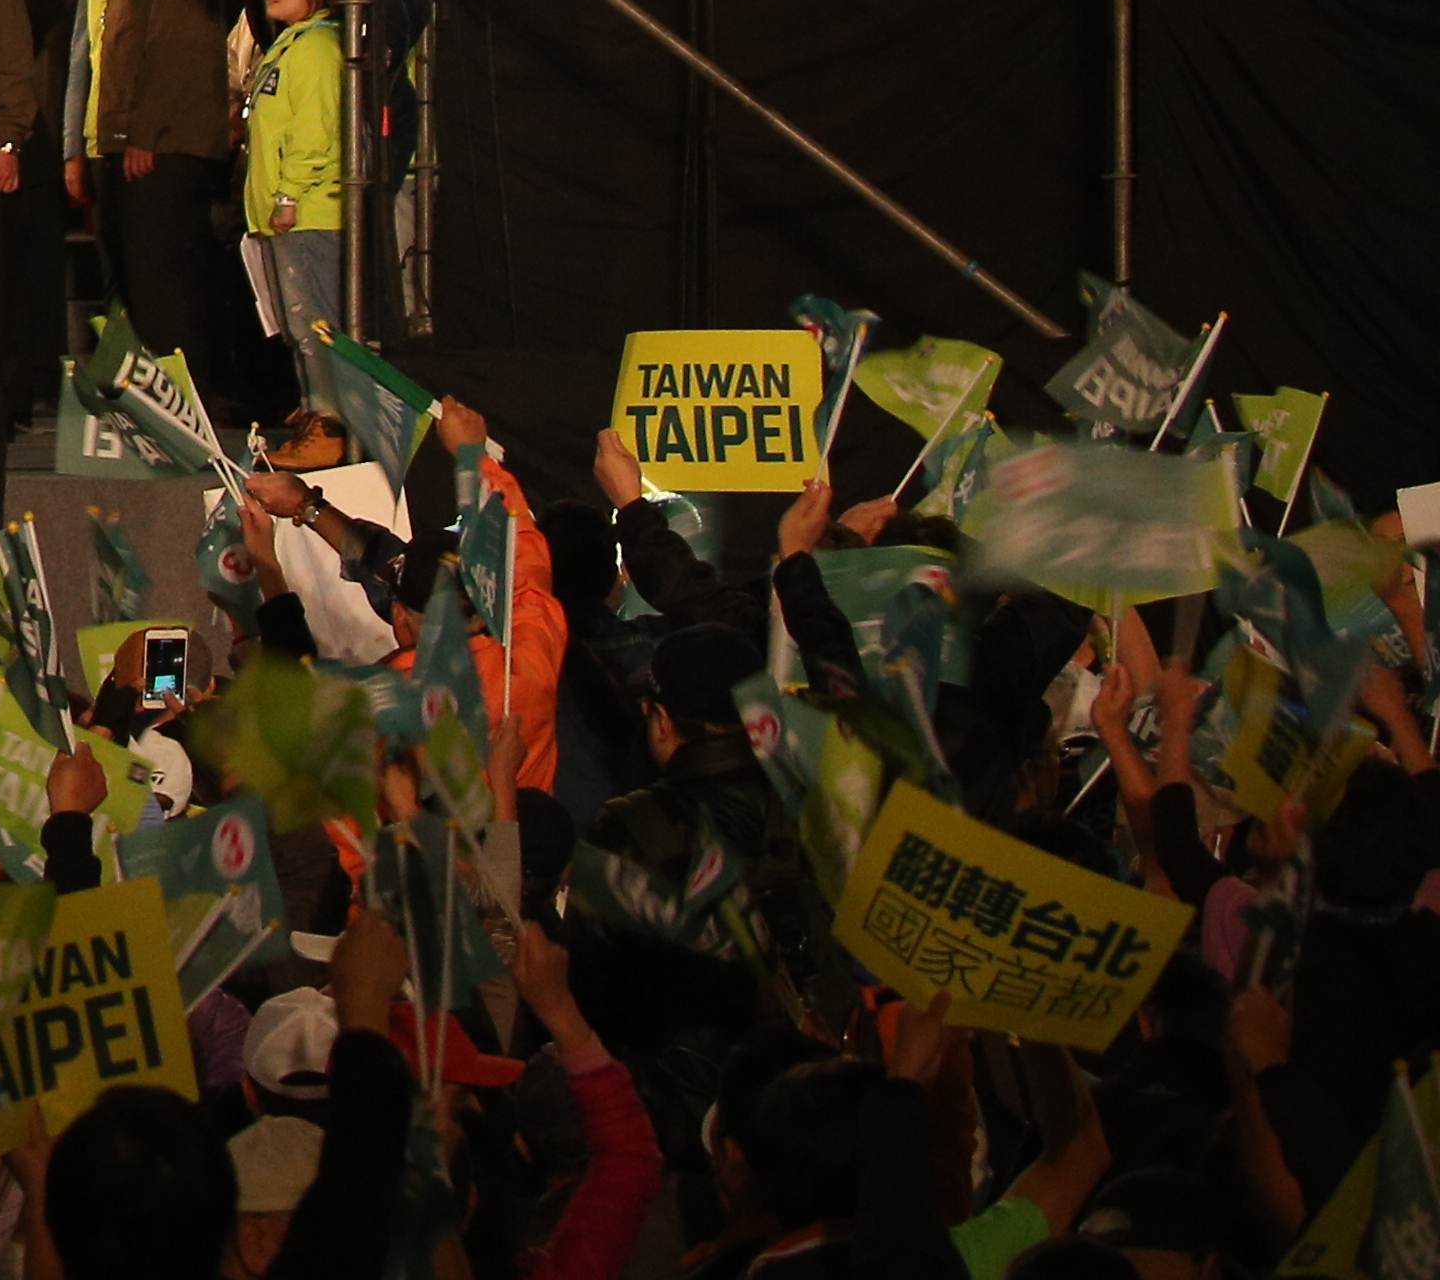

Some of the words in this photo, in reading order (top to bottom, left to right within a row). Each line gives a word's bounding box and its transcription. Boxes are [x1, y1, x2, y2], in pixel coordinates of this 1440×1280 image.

[637, 362, 792, 401] TAIWAN
[625, 404, 806, 464] TAIPEI
[862, 883, 1123, 1026] 國家首都
[881, 827, 1152, 982] 翻轉台北
